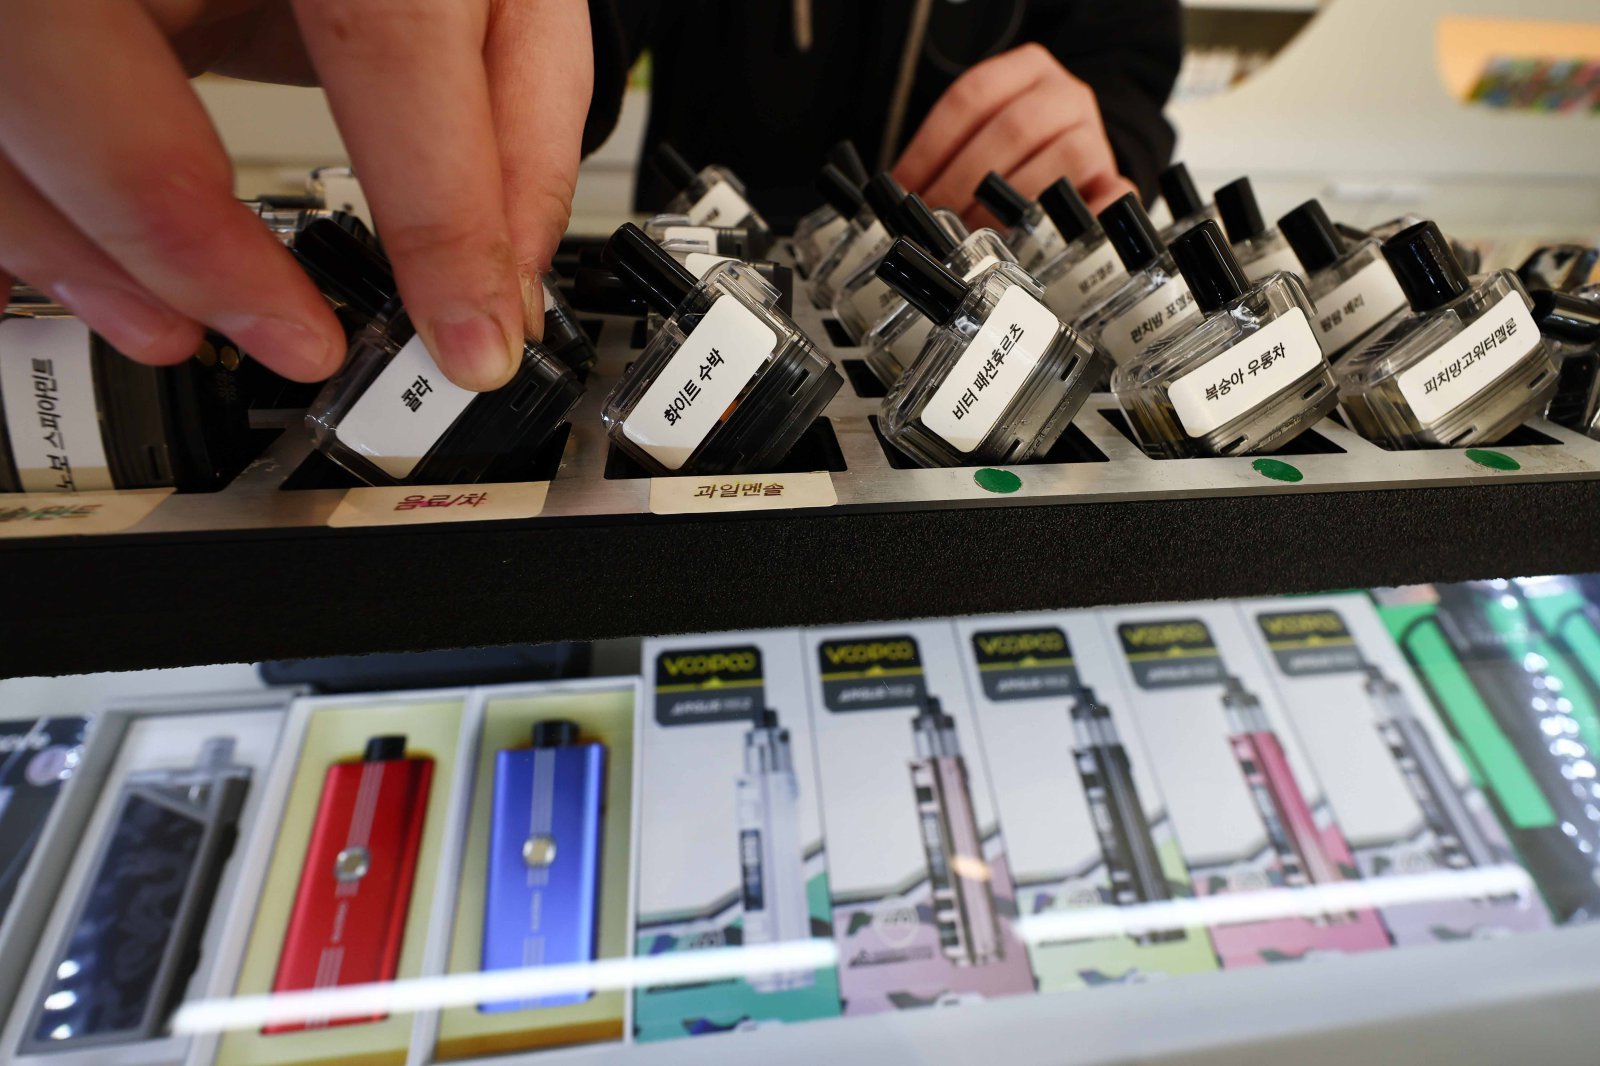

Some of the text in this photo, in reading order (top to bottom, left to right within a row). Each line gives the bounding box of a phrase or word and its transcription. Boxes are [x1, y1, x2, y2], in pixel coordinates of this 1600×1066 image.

[663, 347, 725, 427] 화이트 수박
[952, 323, 1024, 420] 비터 패션후르츠
[1204, 342, 1285, 401] 복숭아 우롱차
[1423, 317, 1517, 395] 피치망고워터멜론
[31, 358, 65, 450] 스피아민트
[401, 374, 433, 413] 콜라
[394, 492, 488, 511] 음료/차
[694, 482, 785, 499] 과일멘솔
